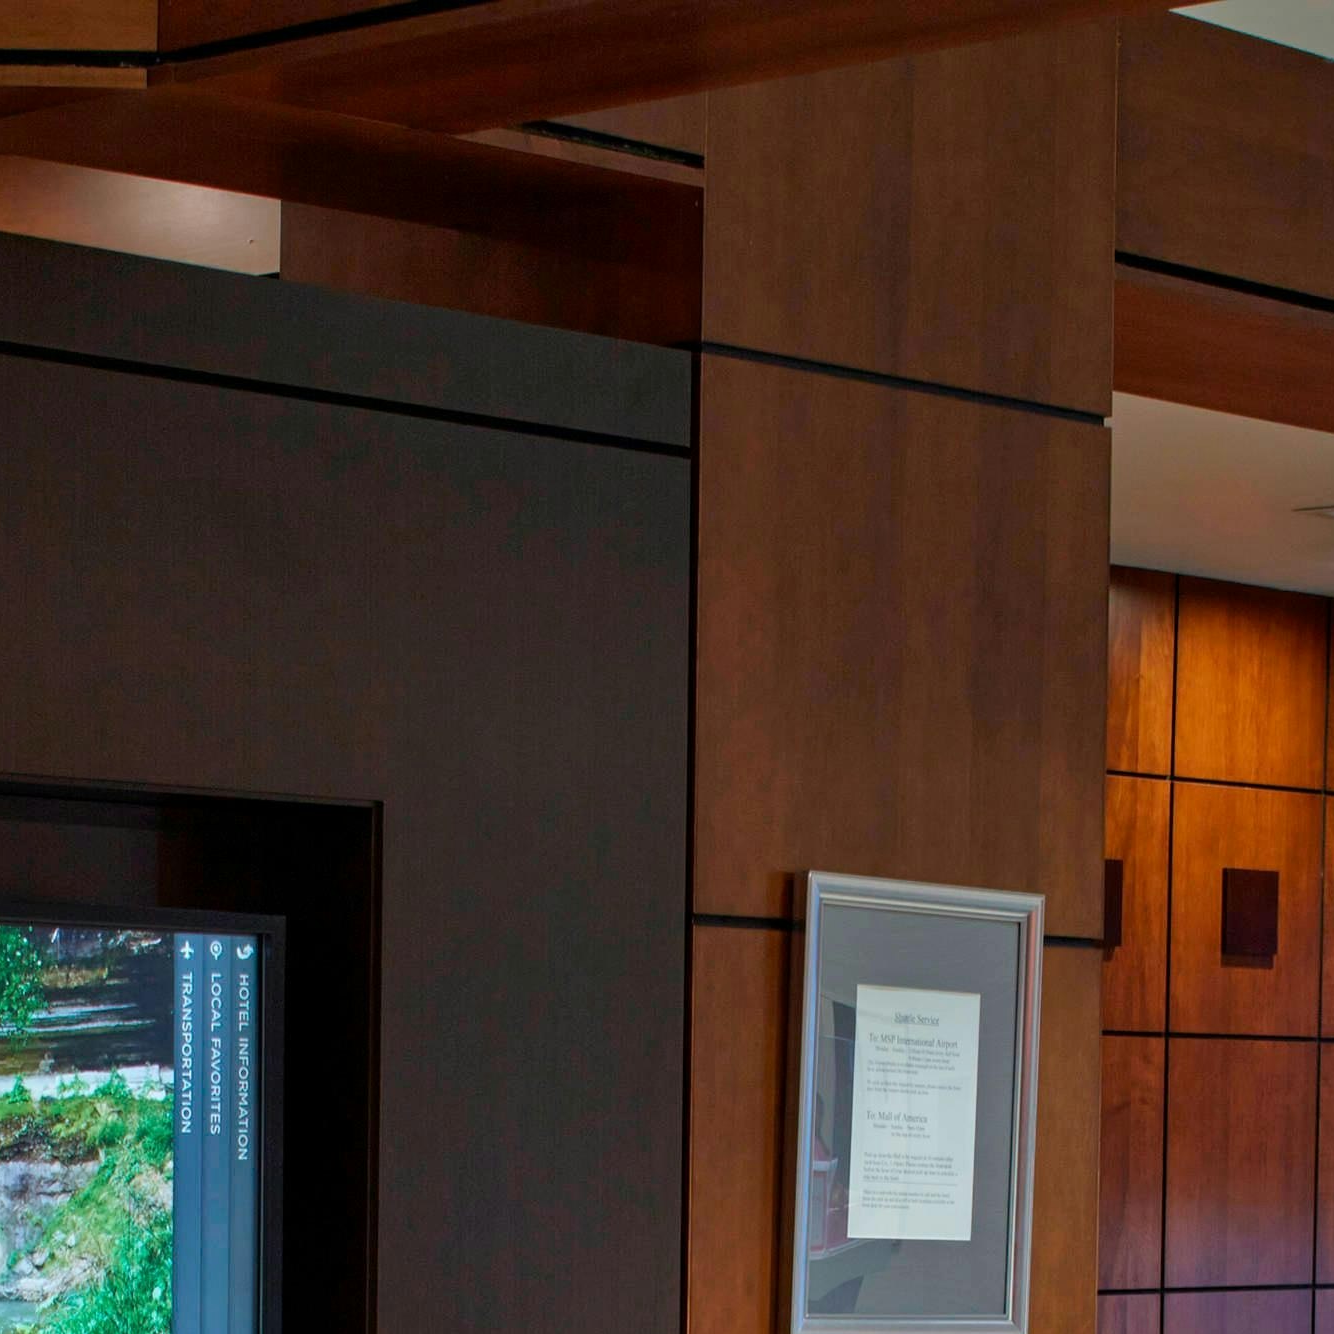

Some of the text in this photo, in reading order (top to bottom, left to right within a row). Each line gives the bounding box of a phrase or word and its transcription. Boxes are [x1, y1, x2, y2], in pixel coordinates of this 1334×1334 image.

[181, 971, 193, 1134] TRANSPORTATION
[210, 973, 222, 1136] LOCAL FAVORITES
[237, 973, 250, 1161] HOTEL INFORMATION
